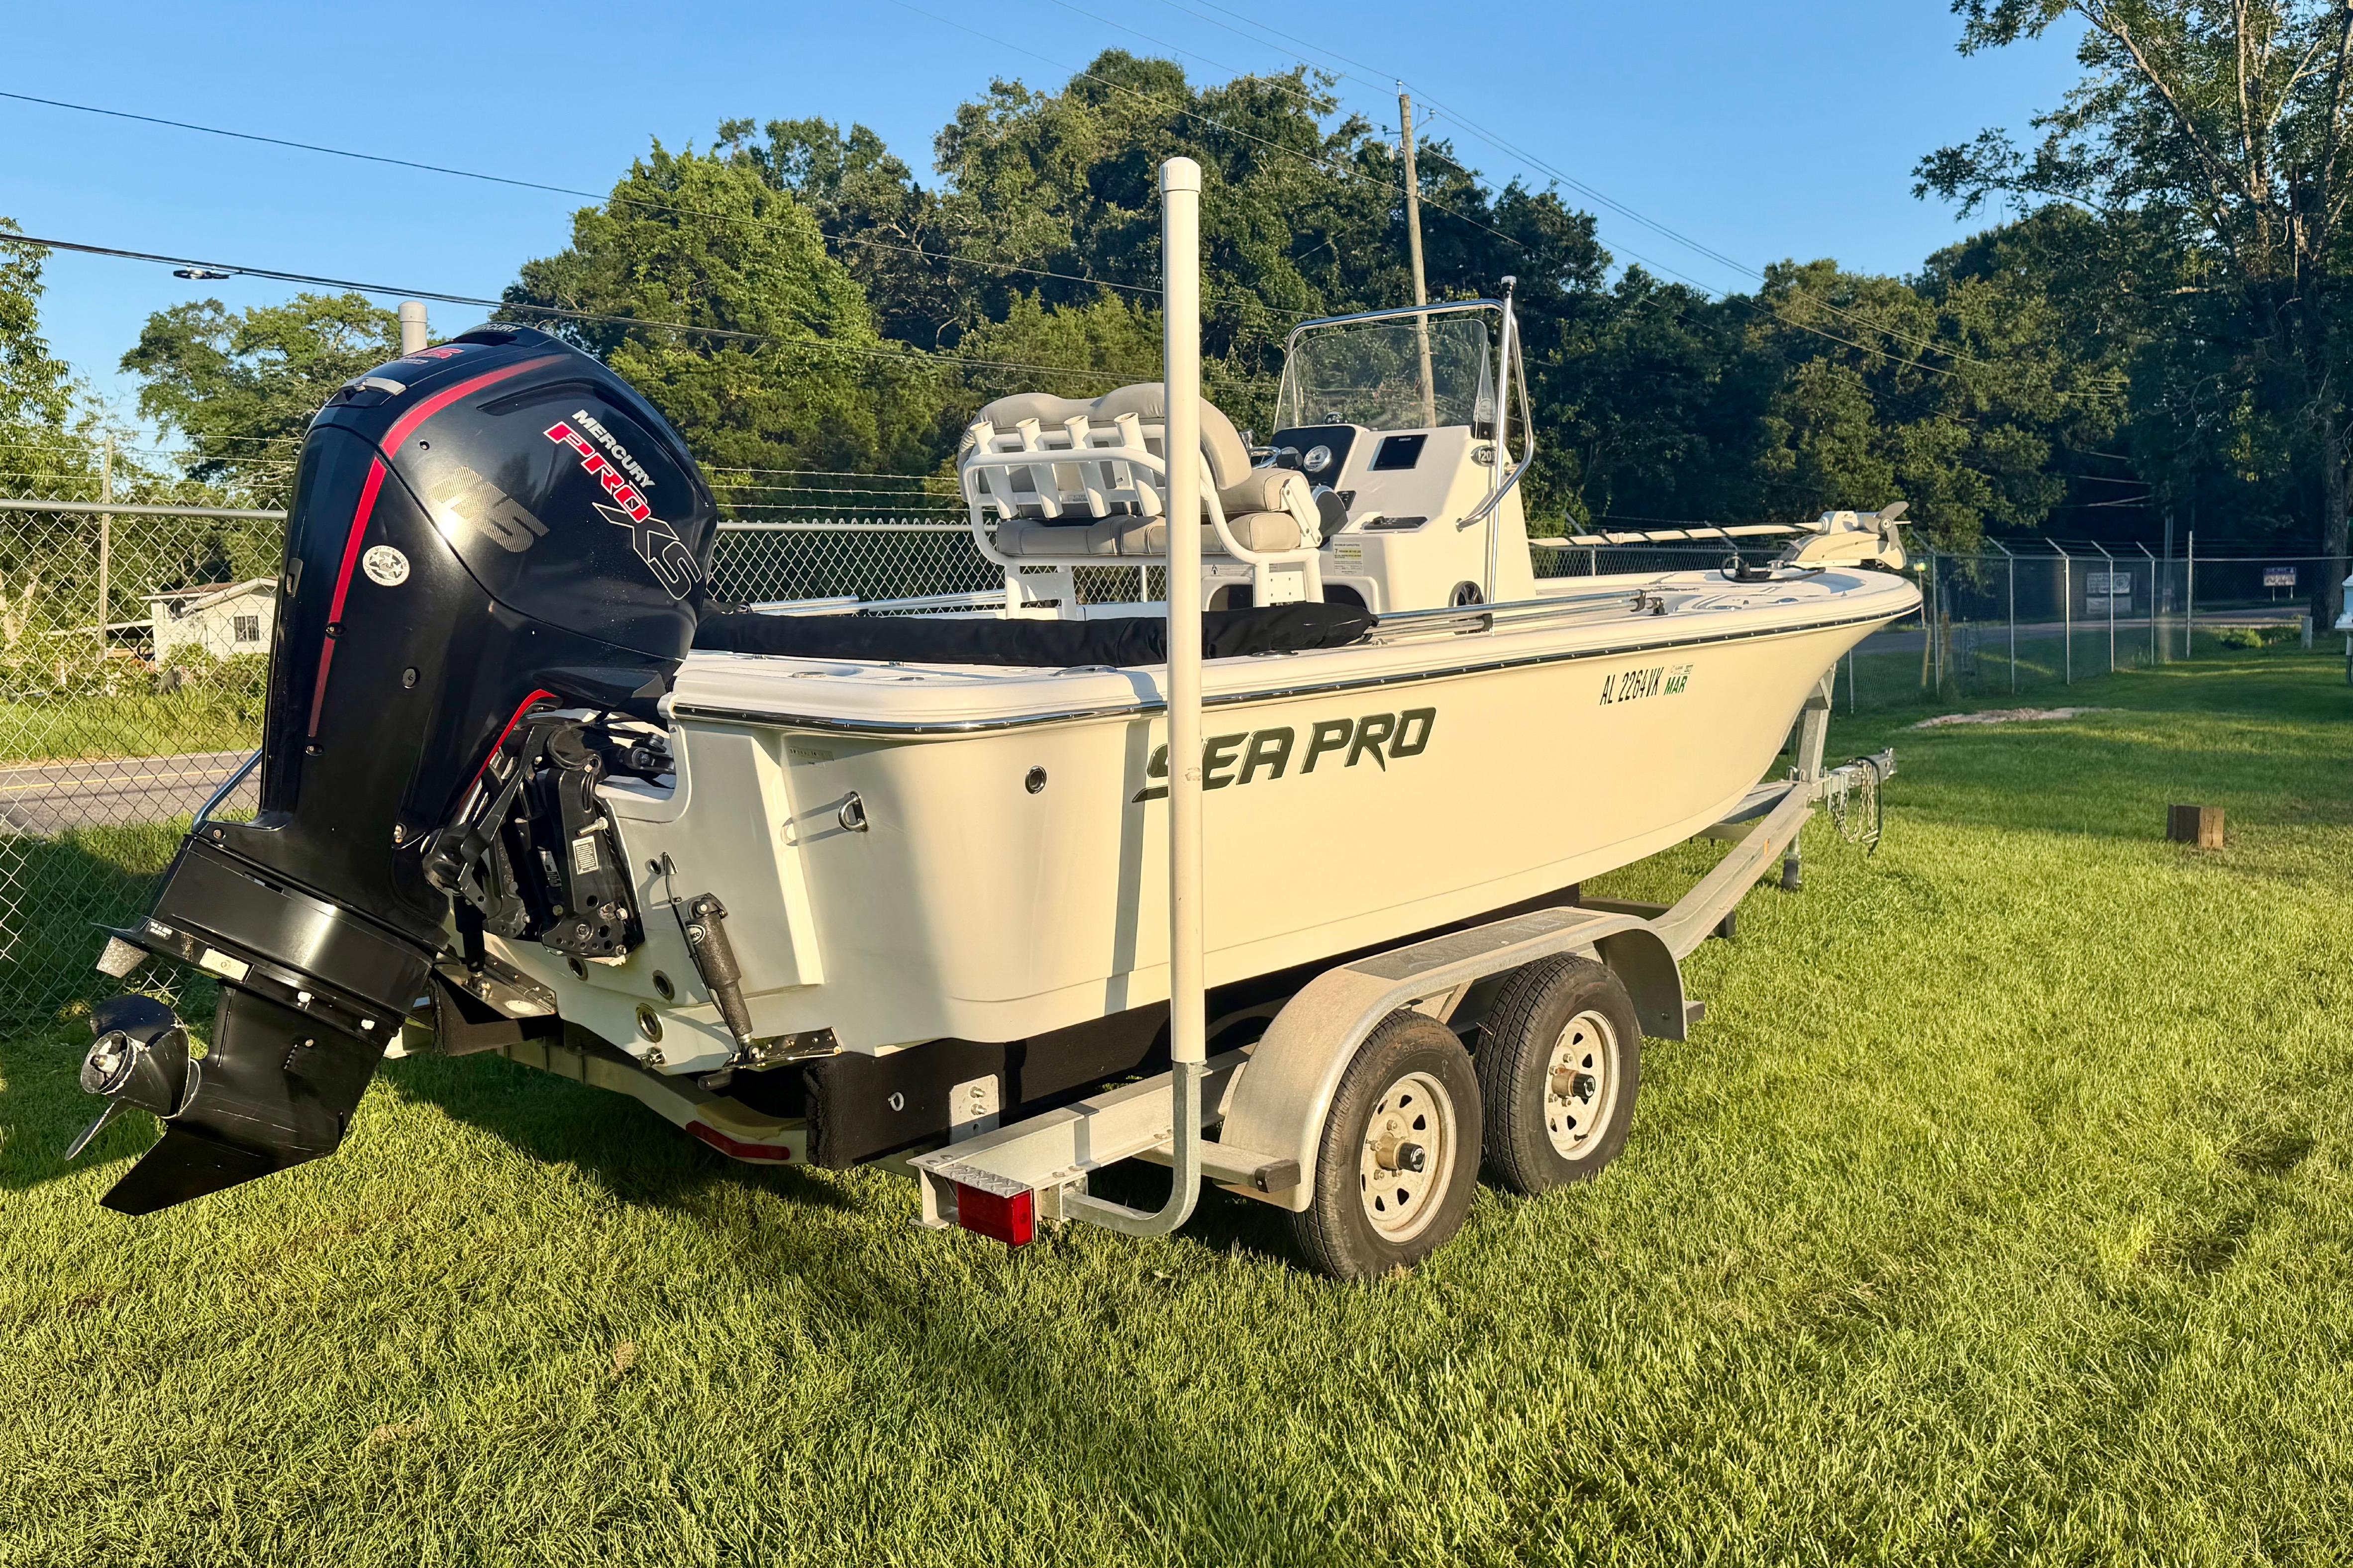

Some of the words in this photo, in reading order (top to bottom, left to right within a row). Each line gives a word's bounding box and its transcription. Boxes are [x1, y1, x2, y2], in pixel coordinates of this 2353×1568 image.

[543, 421, 651, 523] PRO
[572, 409, 655, 488] MERCURY
[592, 481, 703, 600] XS
[1599, 674, 1616, 705] AL
[1618, 667, 1664, 702] 2264VK
[1663, 675, 1688, 695] MAR
[1300, 706, 1436, 774] PRO
